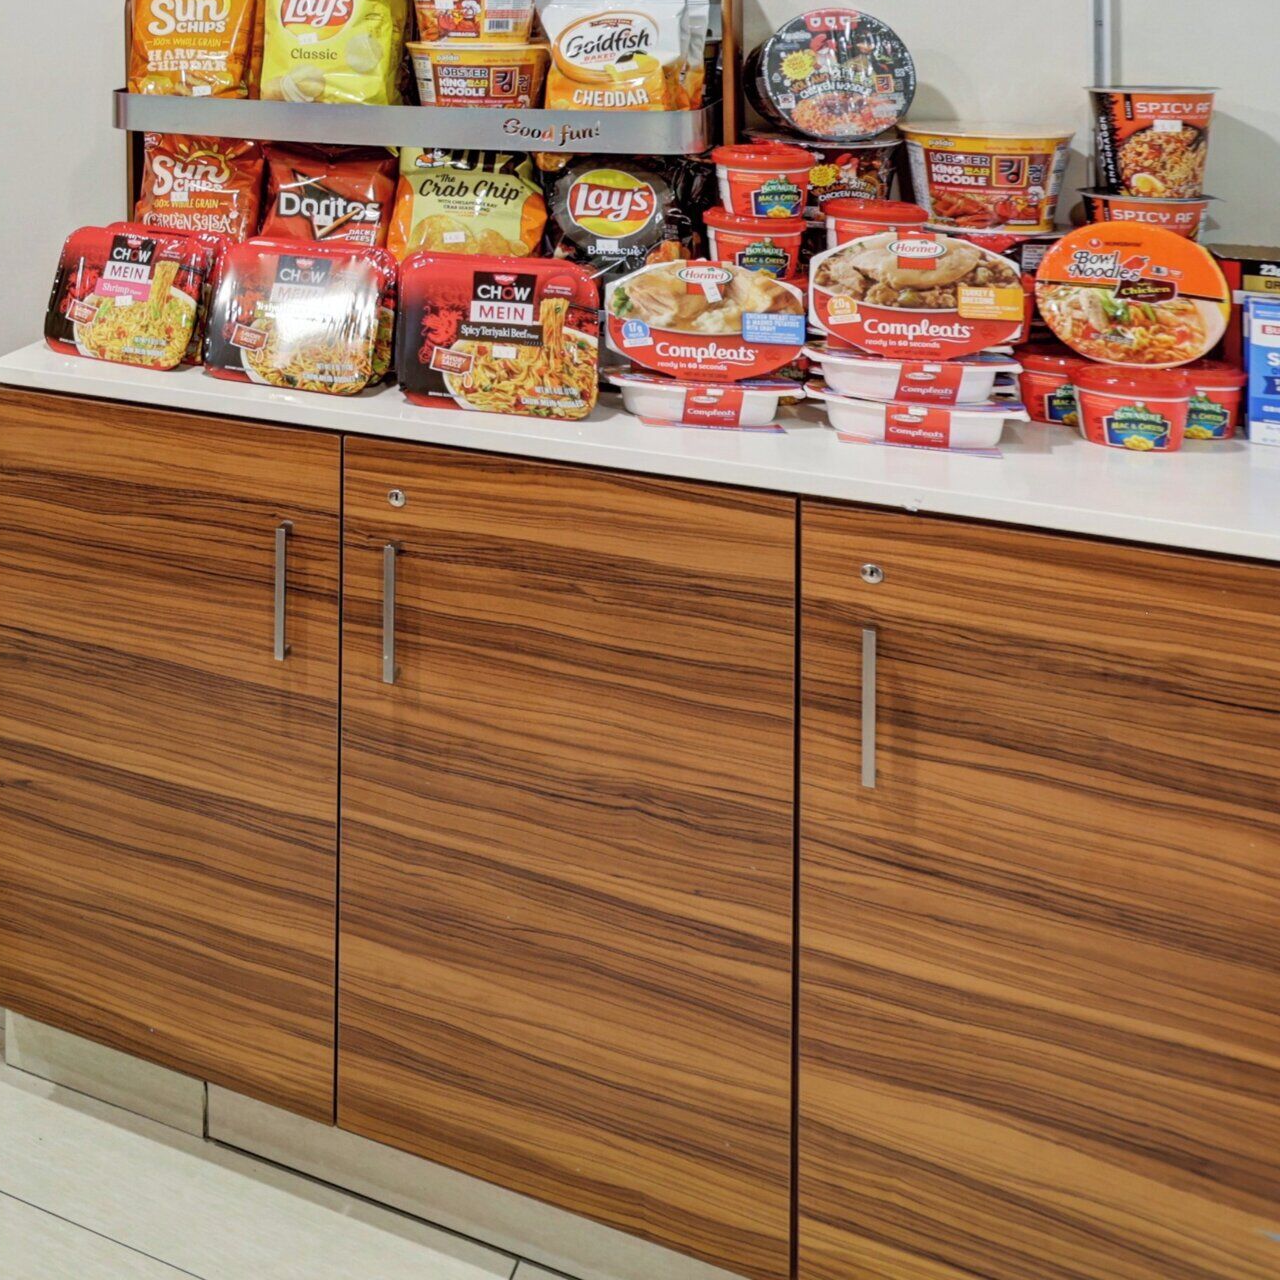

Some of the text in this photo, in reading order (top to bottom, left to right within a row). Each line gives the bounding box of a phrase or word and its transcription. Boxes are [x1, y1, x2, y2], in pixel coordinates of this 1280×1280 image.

[176, 20, 227, 34] CHIPS
[196, 38, 222, 48] GRAIN
[566, 28, 650, 59] Goldfish
[290, 47, 338, 61] Classic
[147, 60, 228, 72] CHEDDAR
[438, 67, 488, 78] LOBSTER
[439, 77, 466, 88] KING
[440, 87, 486, 98] NOODLE
[572, 88, 650, 108] CHEDDAR
[1136, 103, 1193, 114] SPICY
[503, 117, 601, 147] Good fun!
[930, 152, 990, 166] LOBSTER
[152, 155, 232, 195] Sun
[931, 165, 965, 175] KING
[931, 174, 987, 186] NOODLE
[419, 179, 470, 198] Crab
[195, 198, 220, 209] GRAIN
[280, 192, 383, 221] Doritos
[573, 183, 649, 221] Lay's
[1113, 209, 1194, 223] SPICY AF
[112, 247, 151, 263] CHOW
[587, 245, 641, 257] Barbecue
[894, 243, 939, 254] Hormel
[1073, 250, 1120, 265] Bowl
[109, 264, 145, 280] MEIN
[279, 267, 326, 284] CHOW
[684, 271, 725, 281] Hormel
[1069, 263, 1141, 280] Noodles
[101, 282, 130, 296] Shrimp
[476, 284, 531, 302] CHOW
[1120, 284, 1171, 296] Chicken
[478, 304, 526, 322] MEIN
[460, 324, 527, 338] Spicy Teriyaki Beef
[863, 319, 971, 340] Compleats
[865, 339, 888, 348] ready
[909, 341, 940, 349] seconds
[655, 342, 756, 363] Compleats
[657, 361, 728, 371] ready 60 seconds
[899, 384, 954, 396] Compleats
[687, 407, 736, 418] Compleats
[888, 425, 944, 438] Compleats
